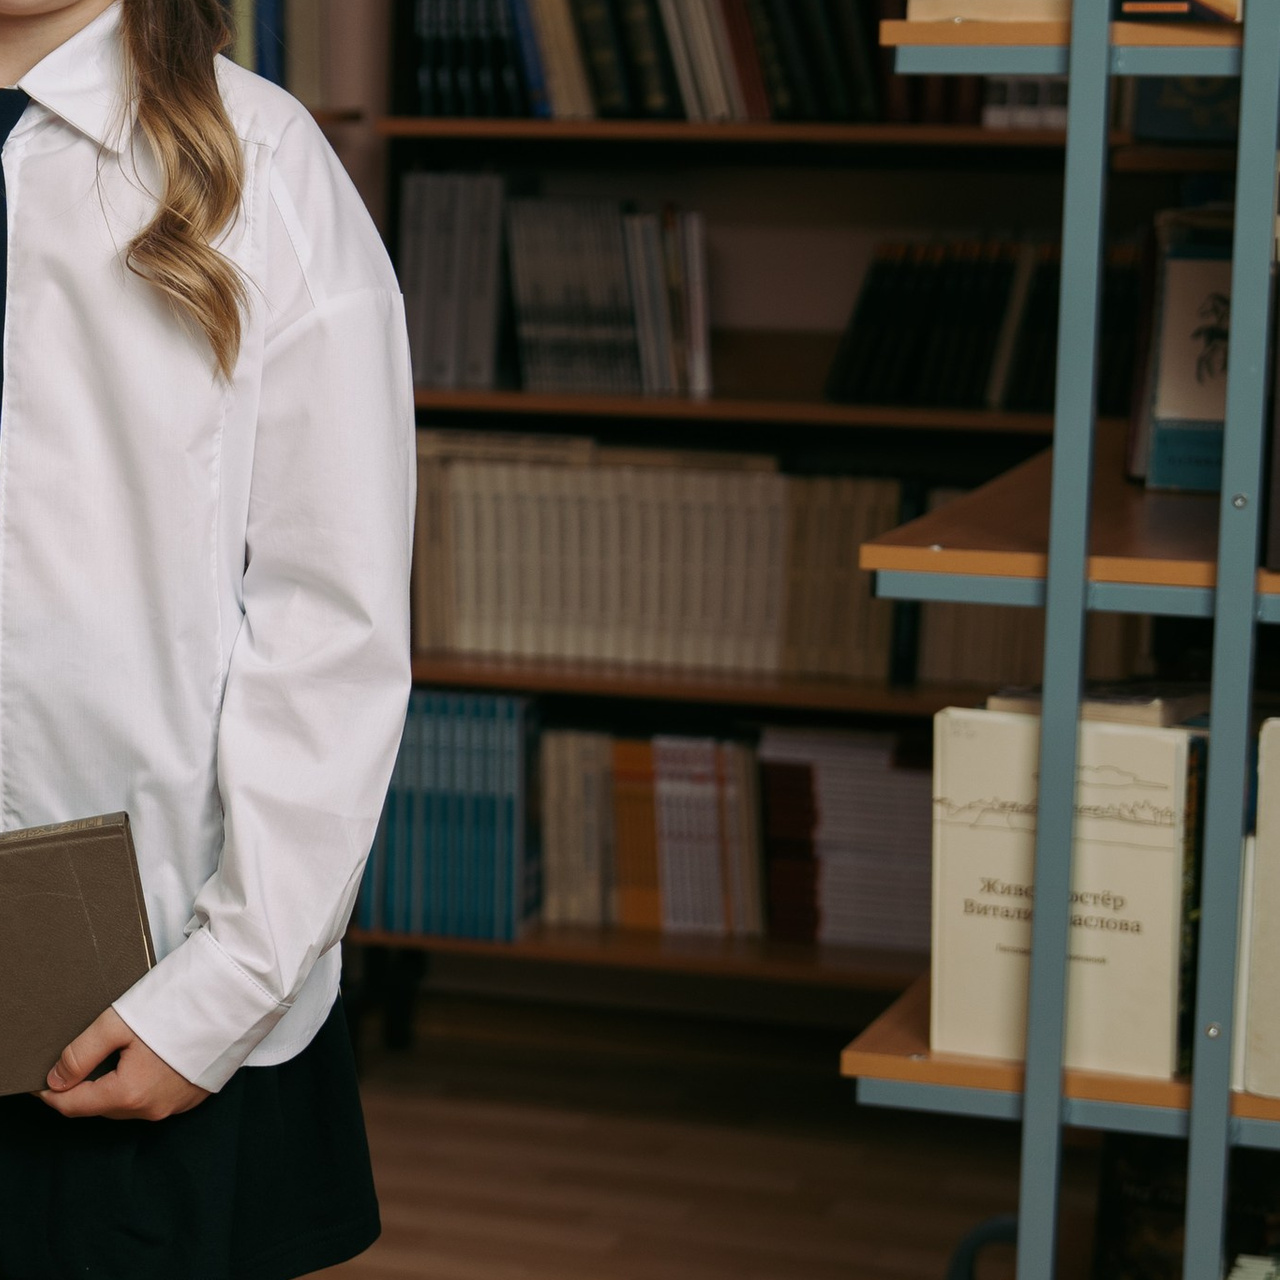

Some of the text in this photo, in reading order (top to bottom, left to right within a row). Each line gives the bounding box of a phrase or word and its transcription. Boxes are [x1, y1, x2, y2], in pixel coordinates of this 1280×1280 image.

[1068, 889, 1126, 913] остёр
[963, 898, 1143, 935] Витали аслова
